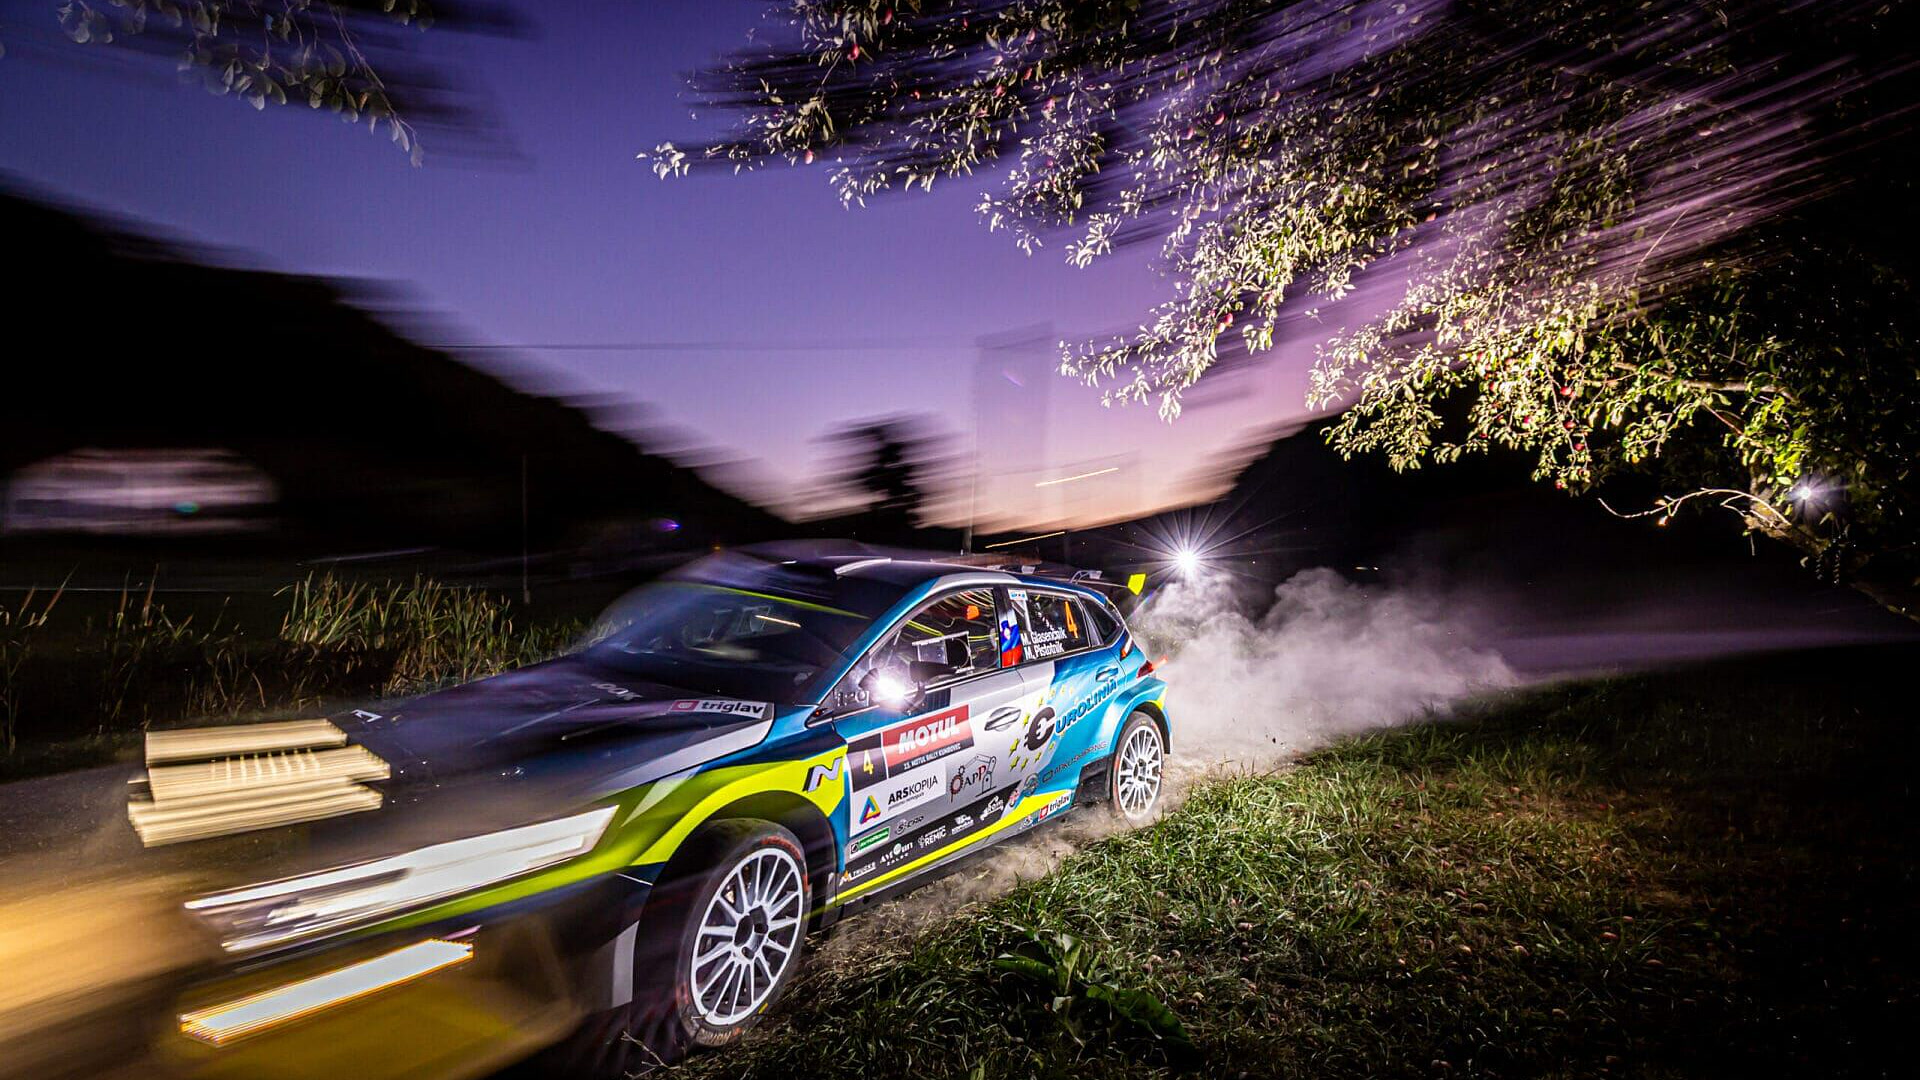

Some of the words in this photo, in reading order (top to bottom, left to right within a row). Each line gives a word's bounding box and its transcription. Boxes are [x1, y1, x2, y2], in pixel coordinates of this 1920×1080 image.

[1064, 599, 1079, 639] 4
[702, 701, 764, 717] triglav
[898, 716, 960, 754] MOTUL
[863, 749, 874, 775] 4
[888, 775, 938, 805] ARSKOPIJA
